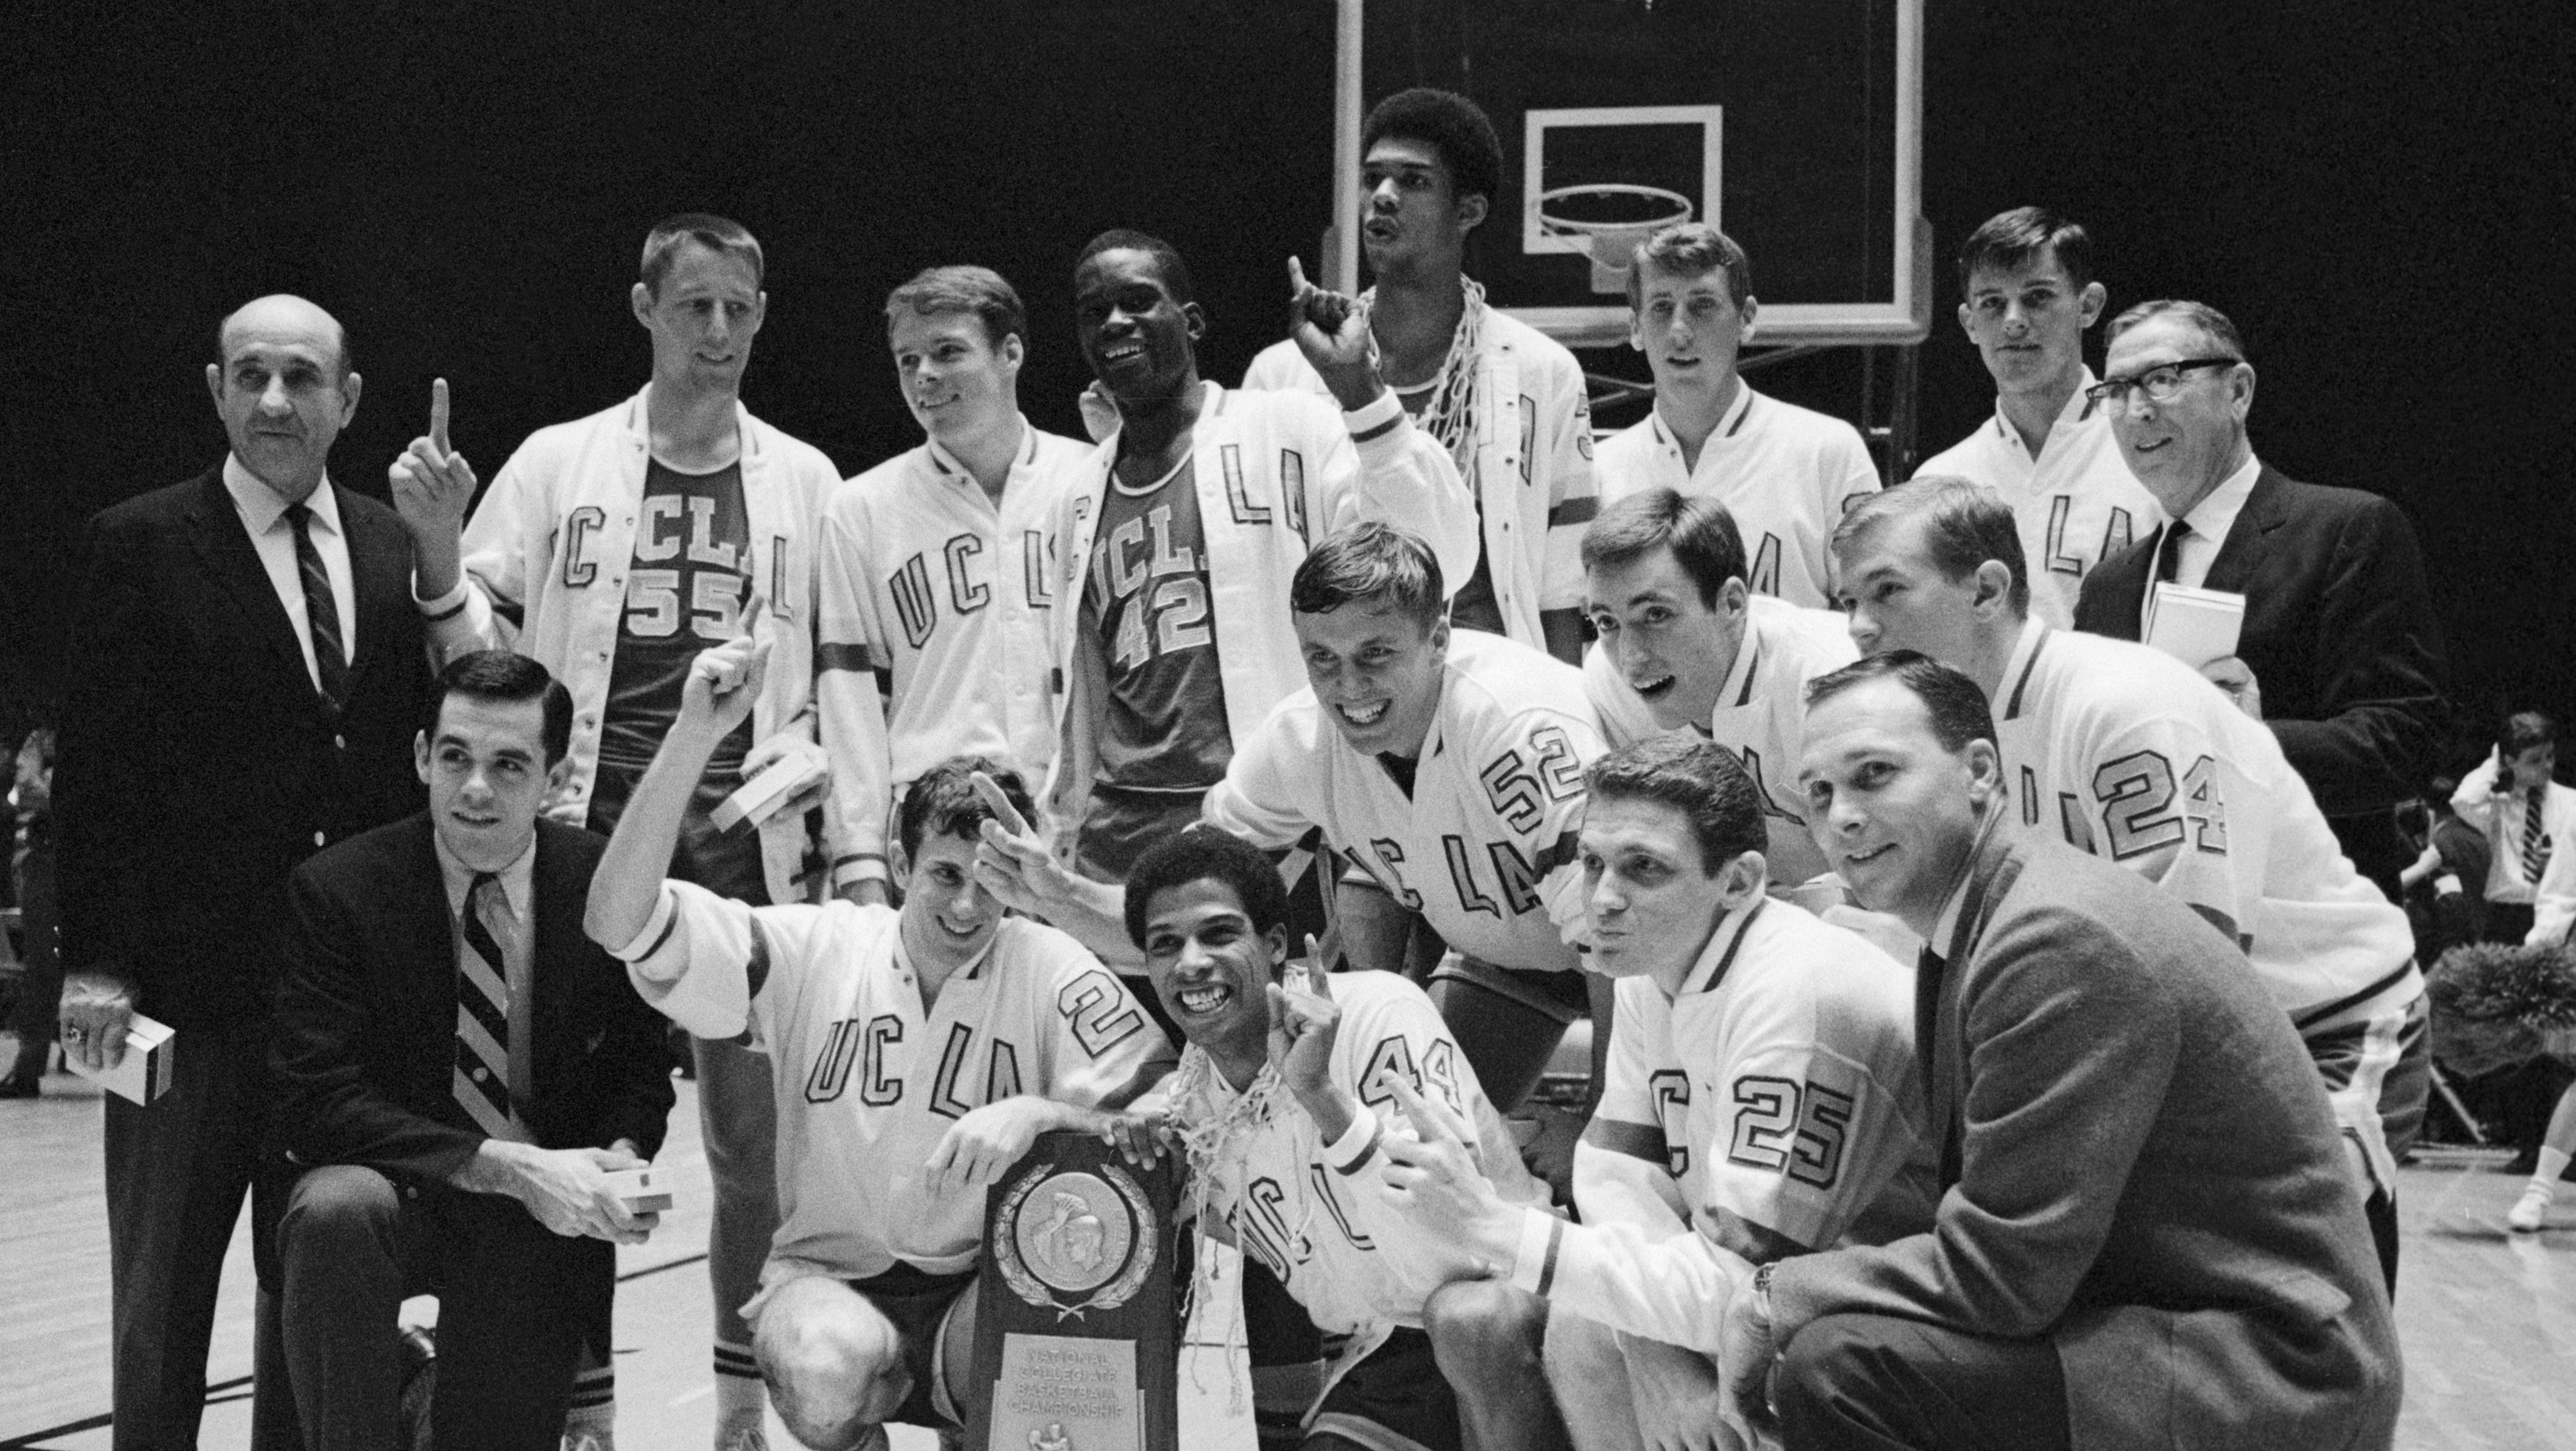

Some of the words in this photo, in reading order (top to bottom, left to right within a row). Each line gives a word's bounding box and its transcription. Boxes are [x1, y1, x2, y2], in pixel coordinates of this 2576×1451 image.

[635, 494, 753, 576] CL
[1091, 504, 1210, 631] CL
[626, 569, 745, 640] 55
[889, 530, 1056, 650] UCL
[1115, 576, 1211, 670] 42
[1480, 726, 1585, 835] 52
[2092, 749, 2227, 862] 24
[804, 1013, 1024, 1120] UCLA
[1357, 1034, 1465, 1120] 44
[1727, 1074, 1855, 1191] 25
[1225, 1163, 1377, 1288] UCL
[1016, 1382, 1119, 1402] BASKETBALL
[1019, 1364, 1117, 1383] COLLEGIATE
[1028, 1349, 1108, 1365] NATIONAL
[1007, 1399, 1122, 1419] CHAMPIONSHIP
